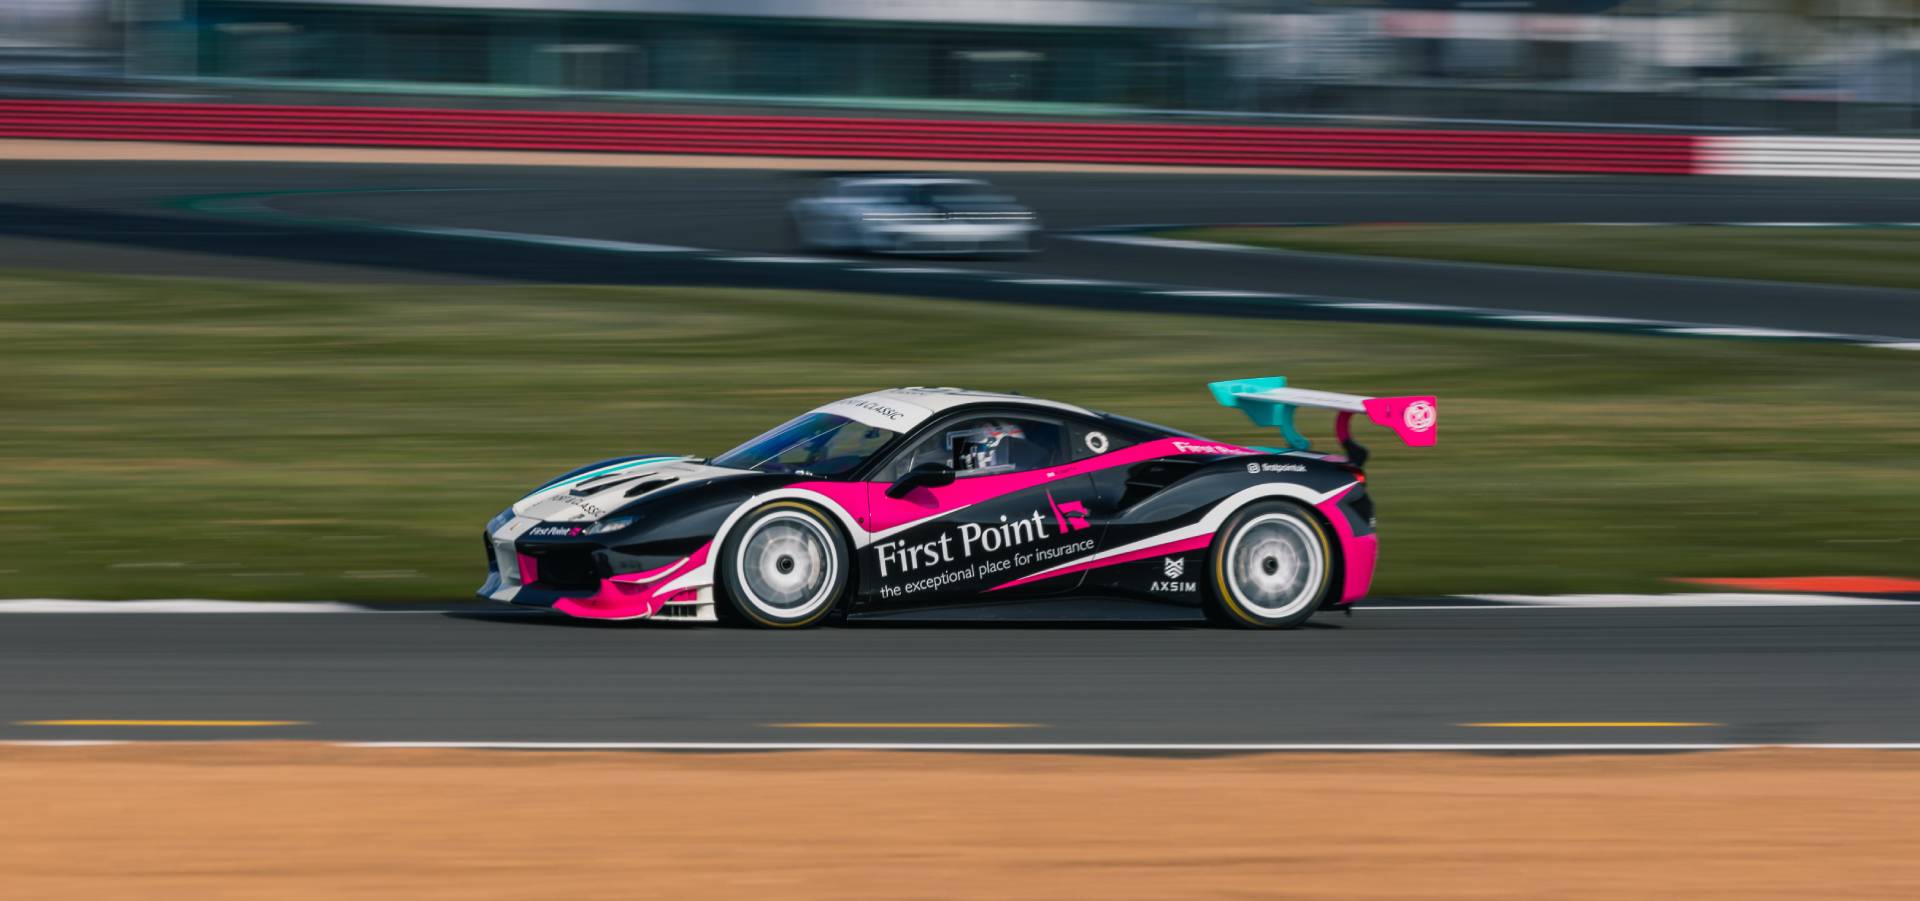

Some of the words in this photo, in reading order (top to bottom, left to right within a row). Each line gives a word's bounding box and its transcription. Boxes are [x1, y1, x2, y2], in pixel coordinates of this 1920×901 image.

[529, 527, 549, 536] First
[547, 526, 570, 536] Point
[874, 532, 955, 577] First
[957, 509, 1049, 557] Point
[880, 585, 902, 599] the
[905, 564, 975, 594] exceptional
[979, 559, 1011, 579] place
[1014, 553, 1033, 568] for
[1035, 539, 1095, 562] insurance
[1151, 581, 1196, 592] AXSIM
